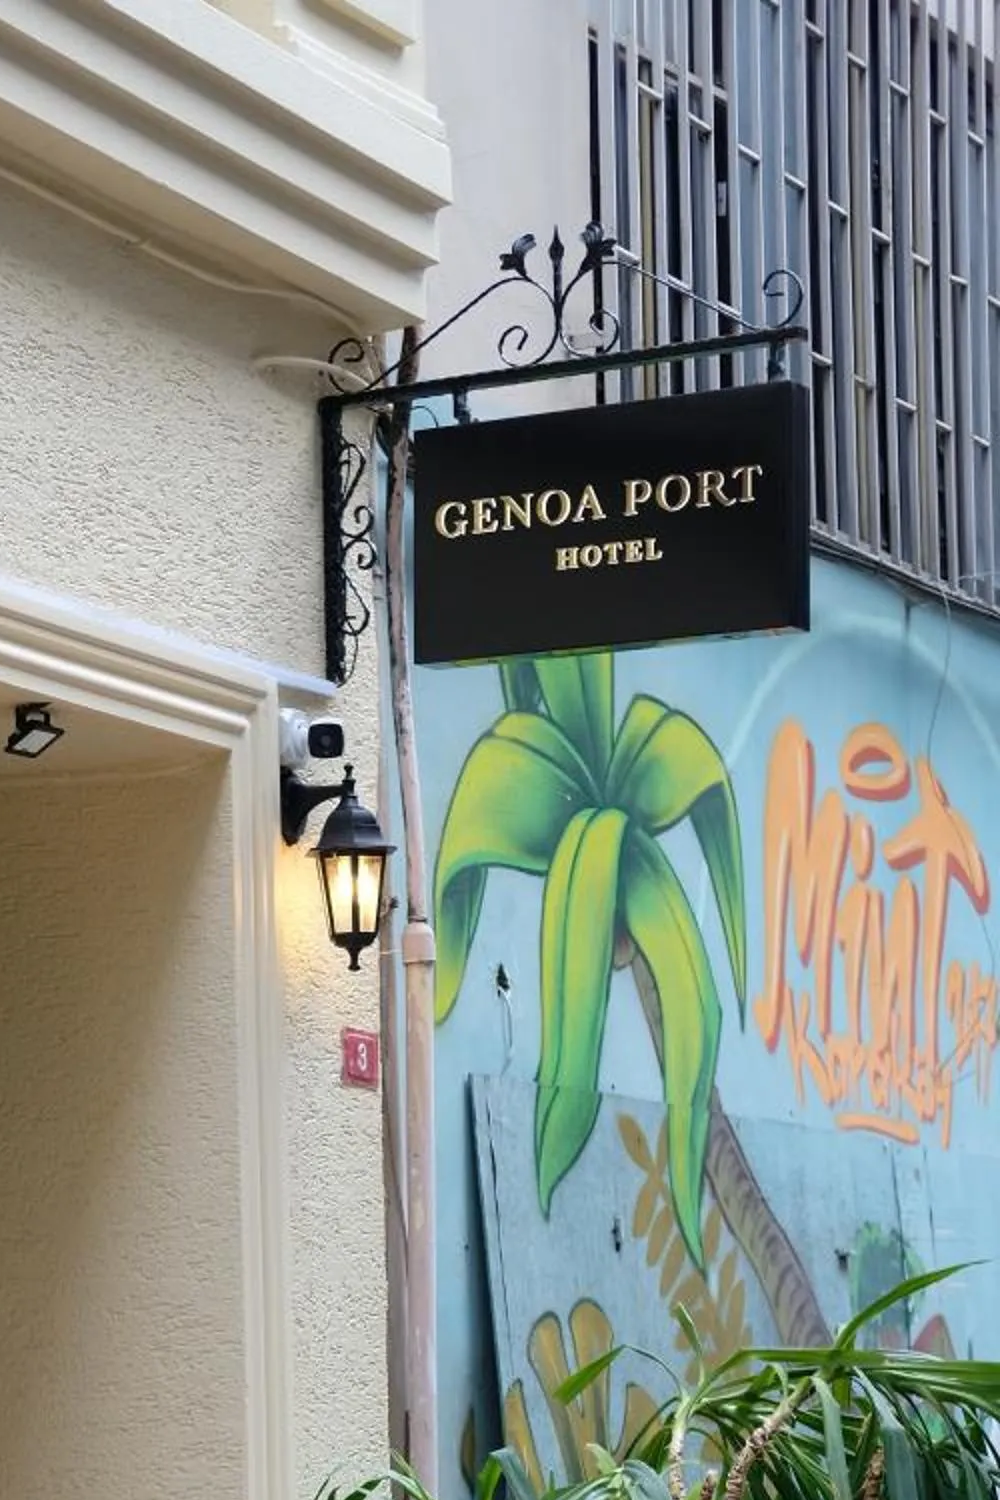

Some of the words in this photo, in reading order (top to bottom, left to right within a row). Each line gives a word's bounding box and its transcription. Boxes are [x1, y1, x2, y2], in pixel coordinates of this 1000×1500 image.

[434, 484, 607, 539] GENOA
[622, 464, 763, 517] PORT
[555, 537, 664, 571] HOTEL
[356, 1042, 368, 1072] 3
